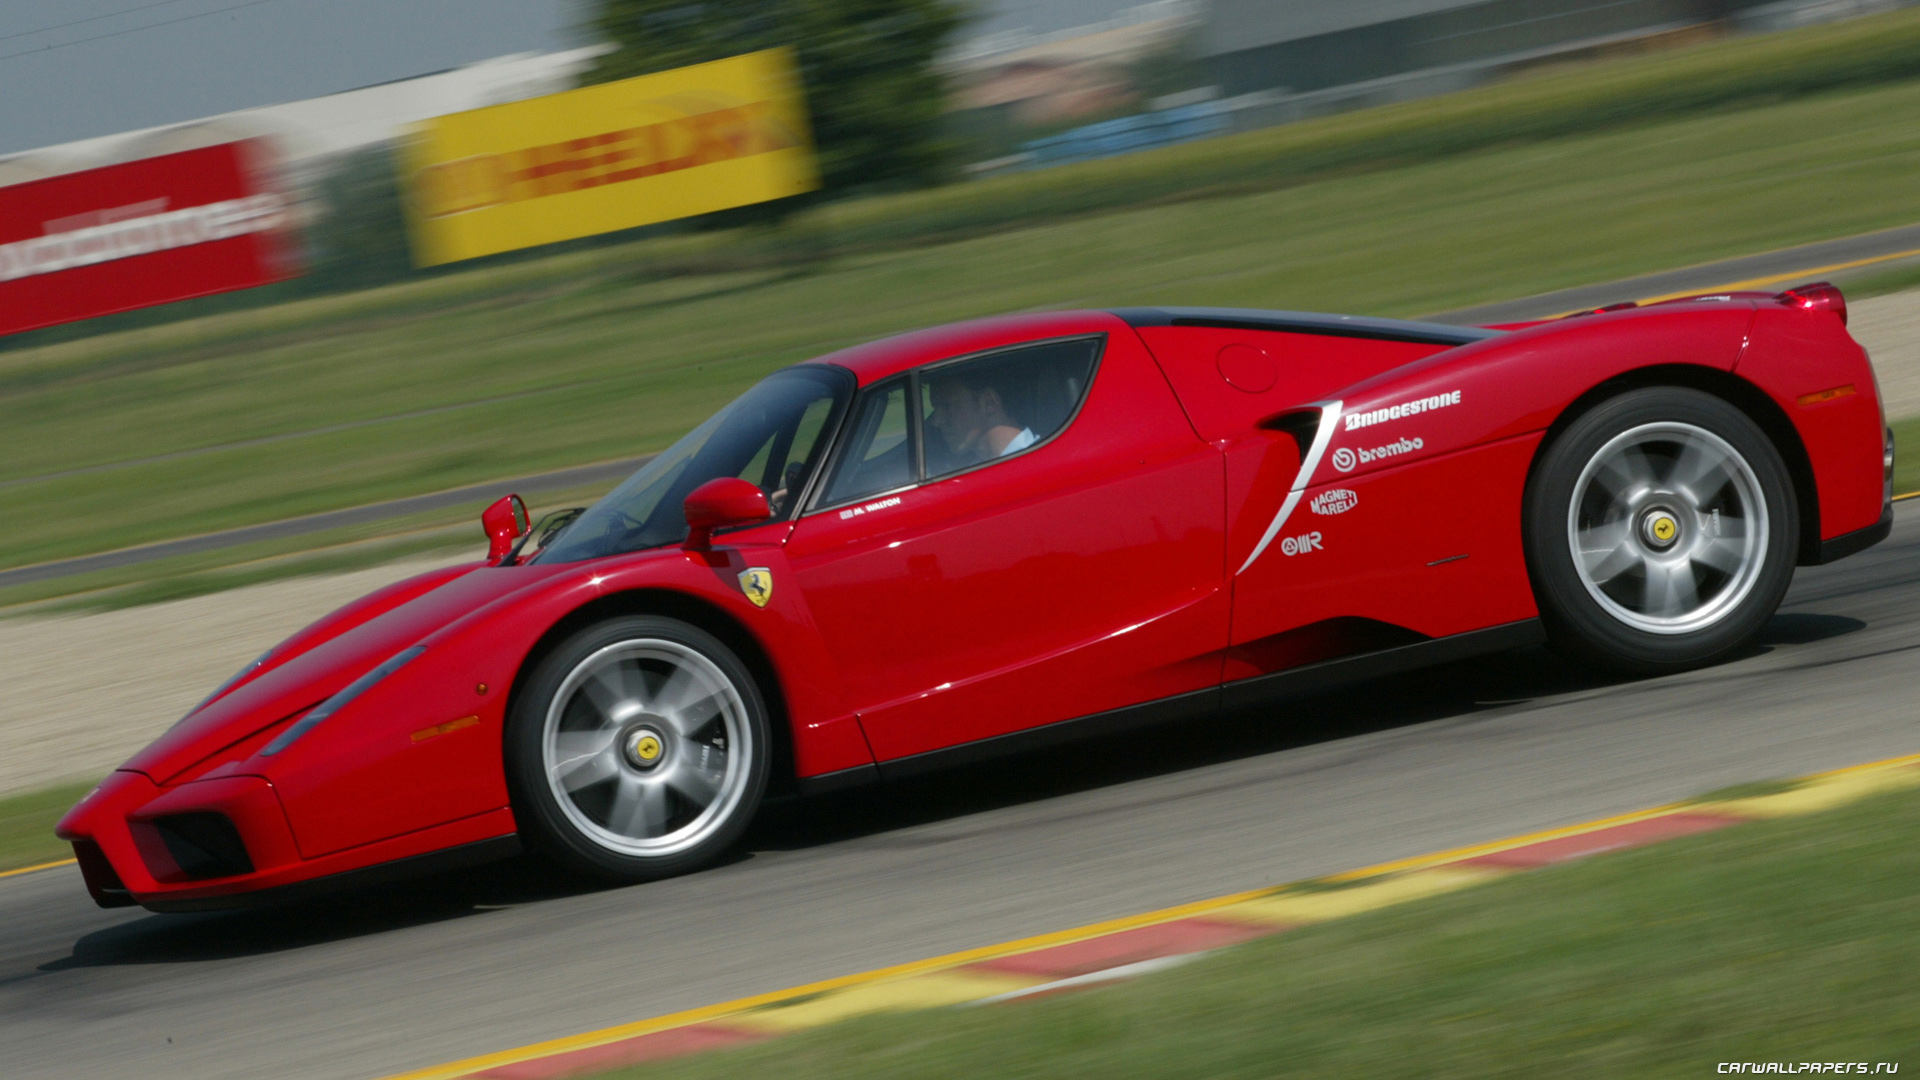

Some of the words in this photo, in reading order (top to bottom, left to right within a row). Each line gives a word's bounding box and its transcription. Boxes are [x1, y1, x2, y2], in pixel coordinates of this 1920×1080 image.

[1345, 390, 1461, 431] BRIDGESTONE
[1358, 437, 1423, 463] brembo
[865, 497, 901, 511] WALTON
[1310, 489, 1358, 509] MAGNETI
[1310, 496, 1358, 516] MARELLI
